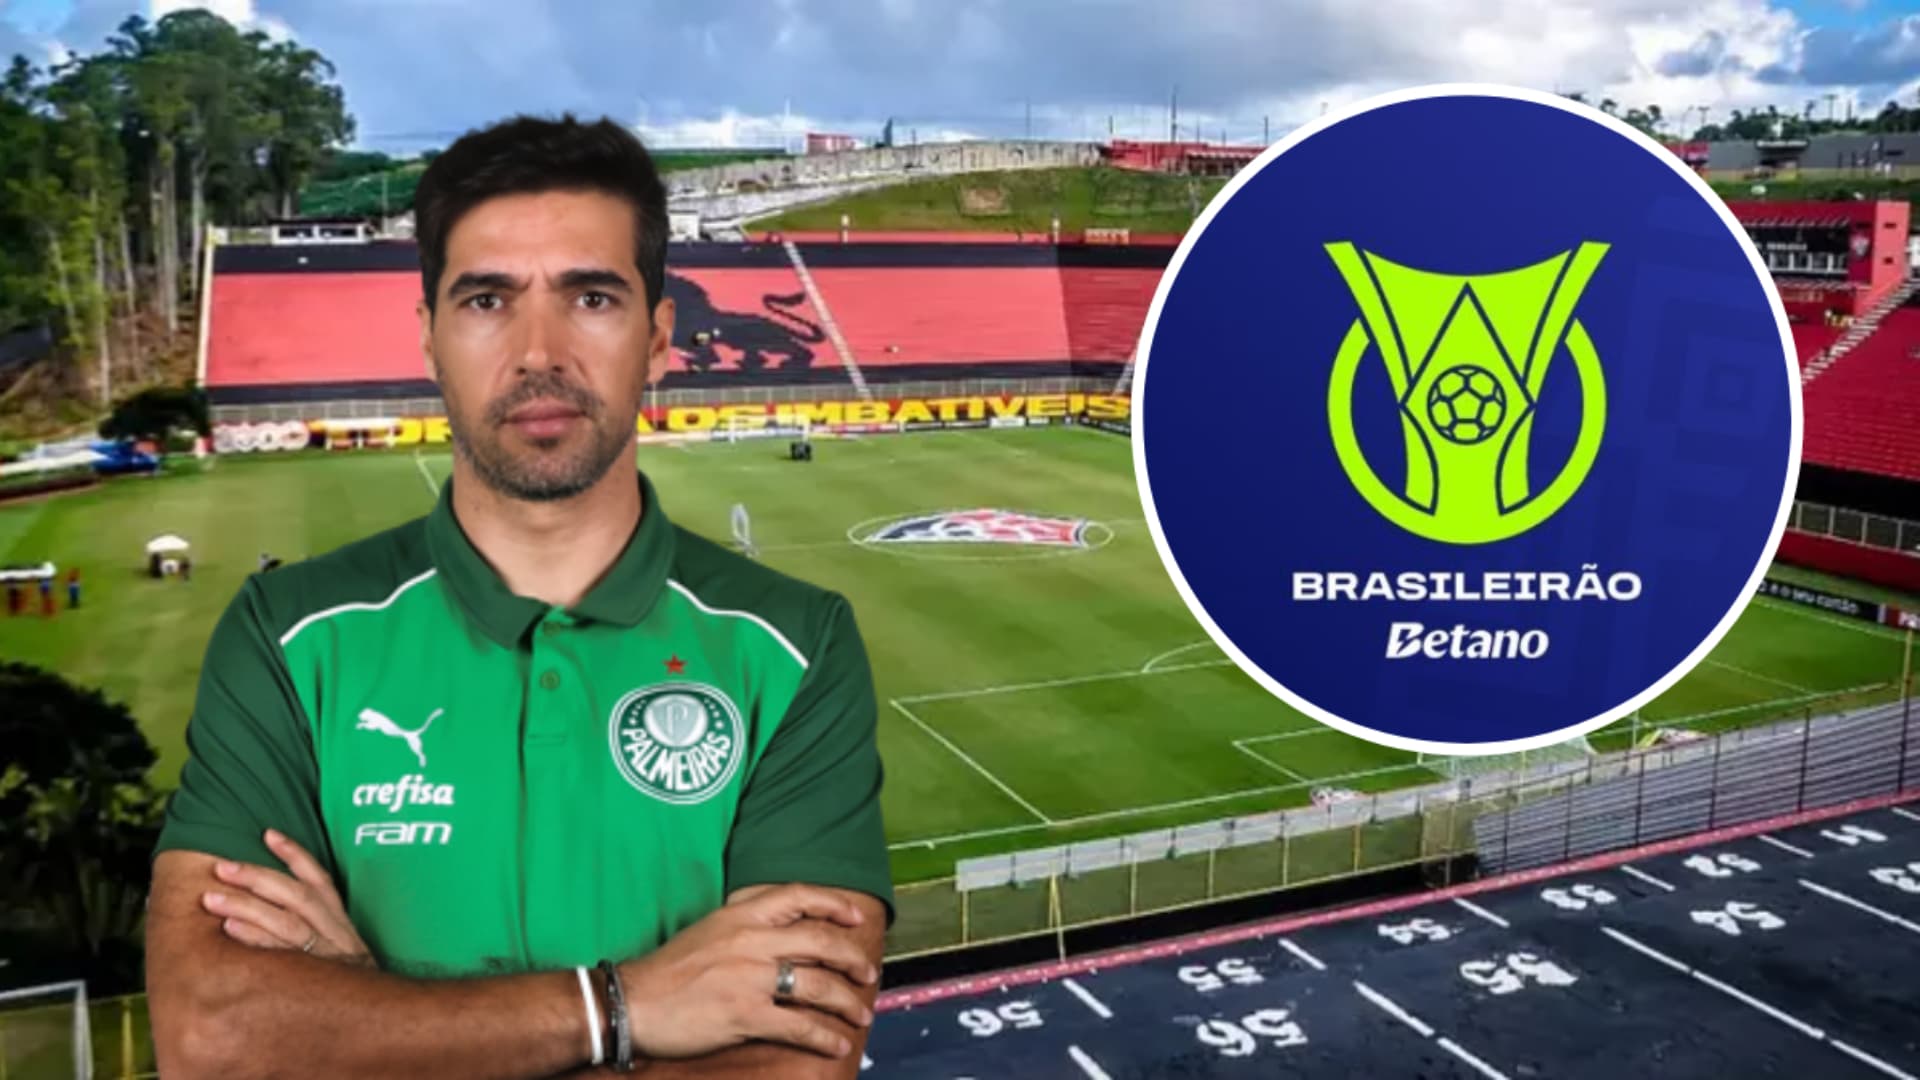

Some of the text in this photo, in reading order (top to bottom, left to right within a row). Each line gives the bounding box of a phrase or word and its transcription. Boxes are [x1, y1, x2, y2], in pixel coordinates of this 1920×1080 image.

[621, 728, 731, 791] PALMEIRAS
[353, 774, 455, 812] crefisa
[1177, 957, 1264, 992] 55
[957, 1000, 1043, 1036] 56
[1195, 1007, 1308, 1056] 56
